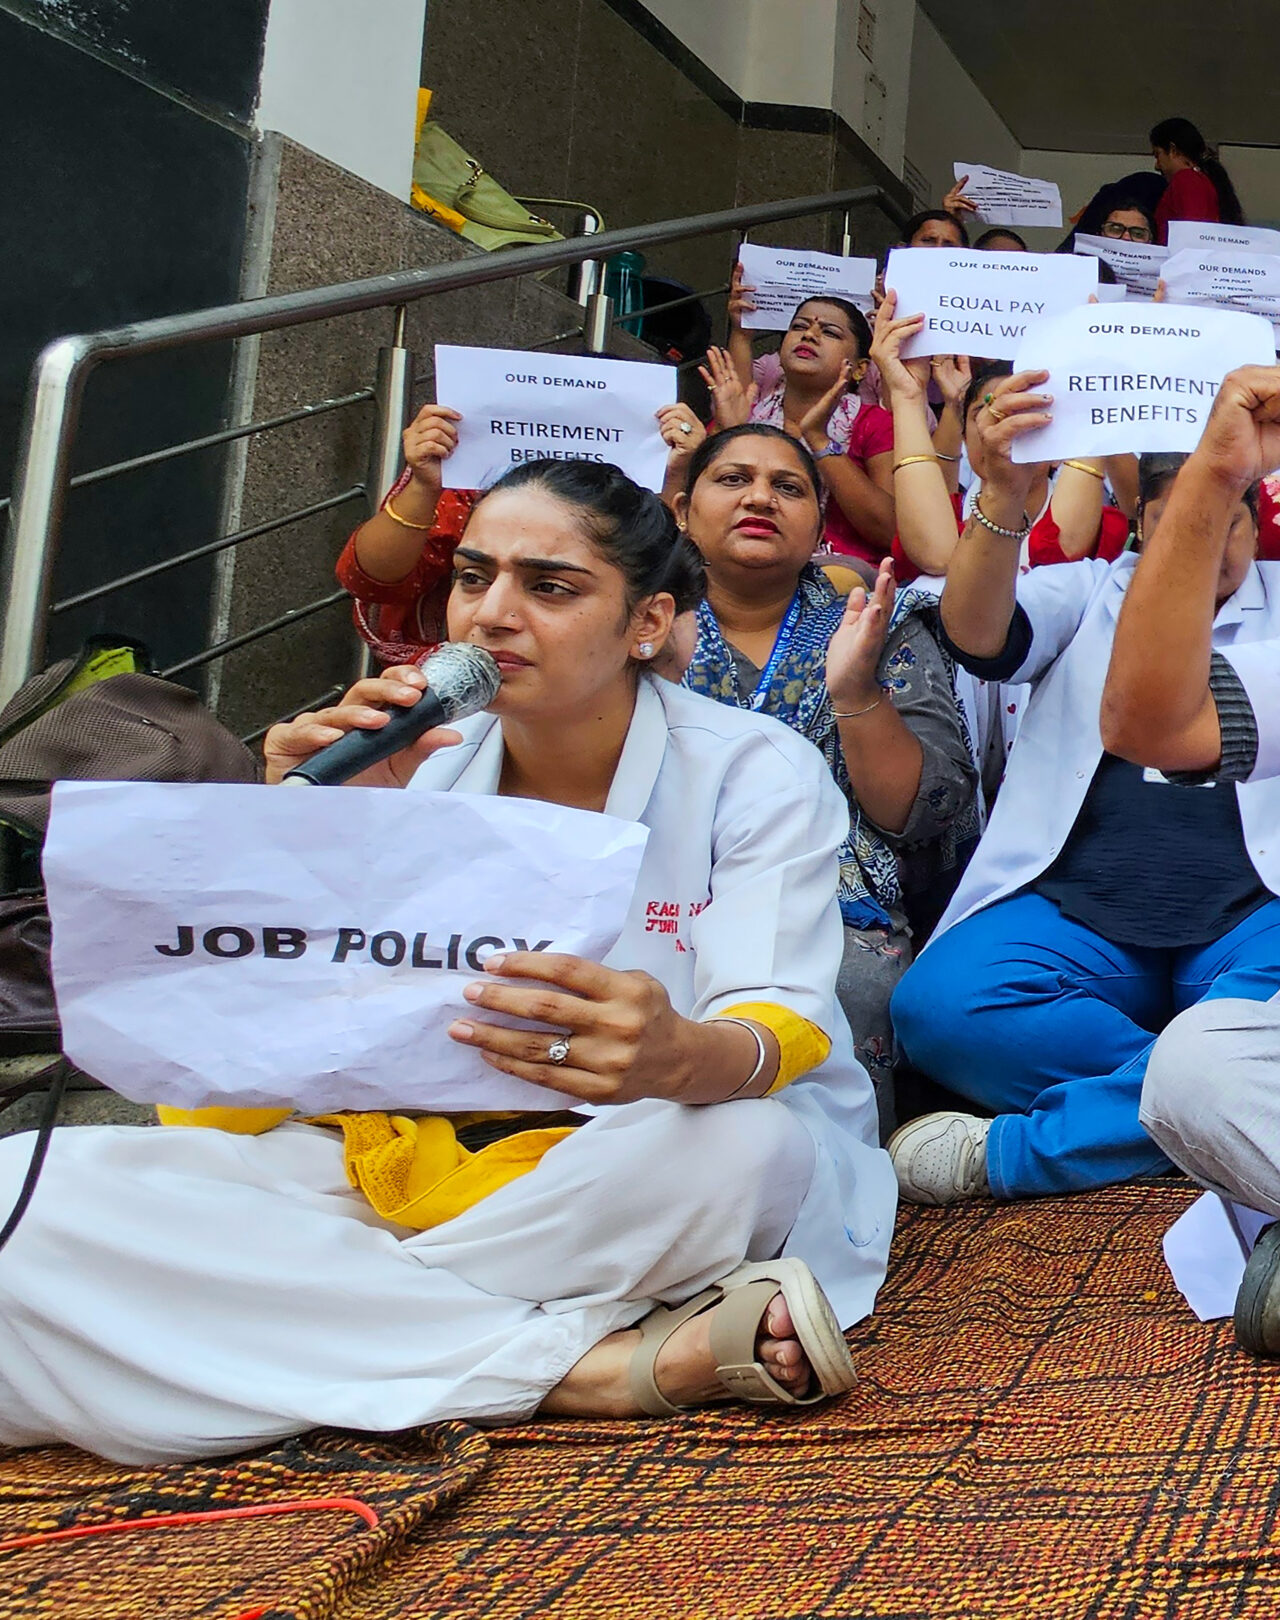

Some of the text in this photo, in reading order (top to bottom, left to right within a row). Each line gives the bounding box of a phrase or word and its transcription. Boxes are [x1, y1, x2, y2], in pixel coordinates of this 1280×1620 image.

[1217, 236, 1250, 245] DEMAND
[776, 260, 841, 273] OUR DEMANDS
[949, 261, 1039, 272] OUR DEMAND
[1199, 264, 1267, 276] OUR DEMANDS
[939, 295, 1045, 315] EQUAL PAY
[928, 318, 993, 336] EQUAL
[1088, 324, 1201, 338] OUR DEMAND
[505, 373, 607, 390] OUR DEMAND
[1068, 374, 1220, 397] RETIREMENT
[1091, 404, 1197, 425] BENEFITS
[490, 420, 624, 443] RETIREMENT
[154, 925, 307, 960] JOB
